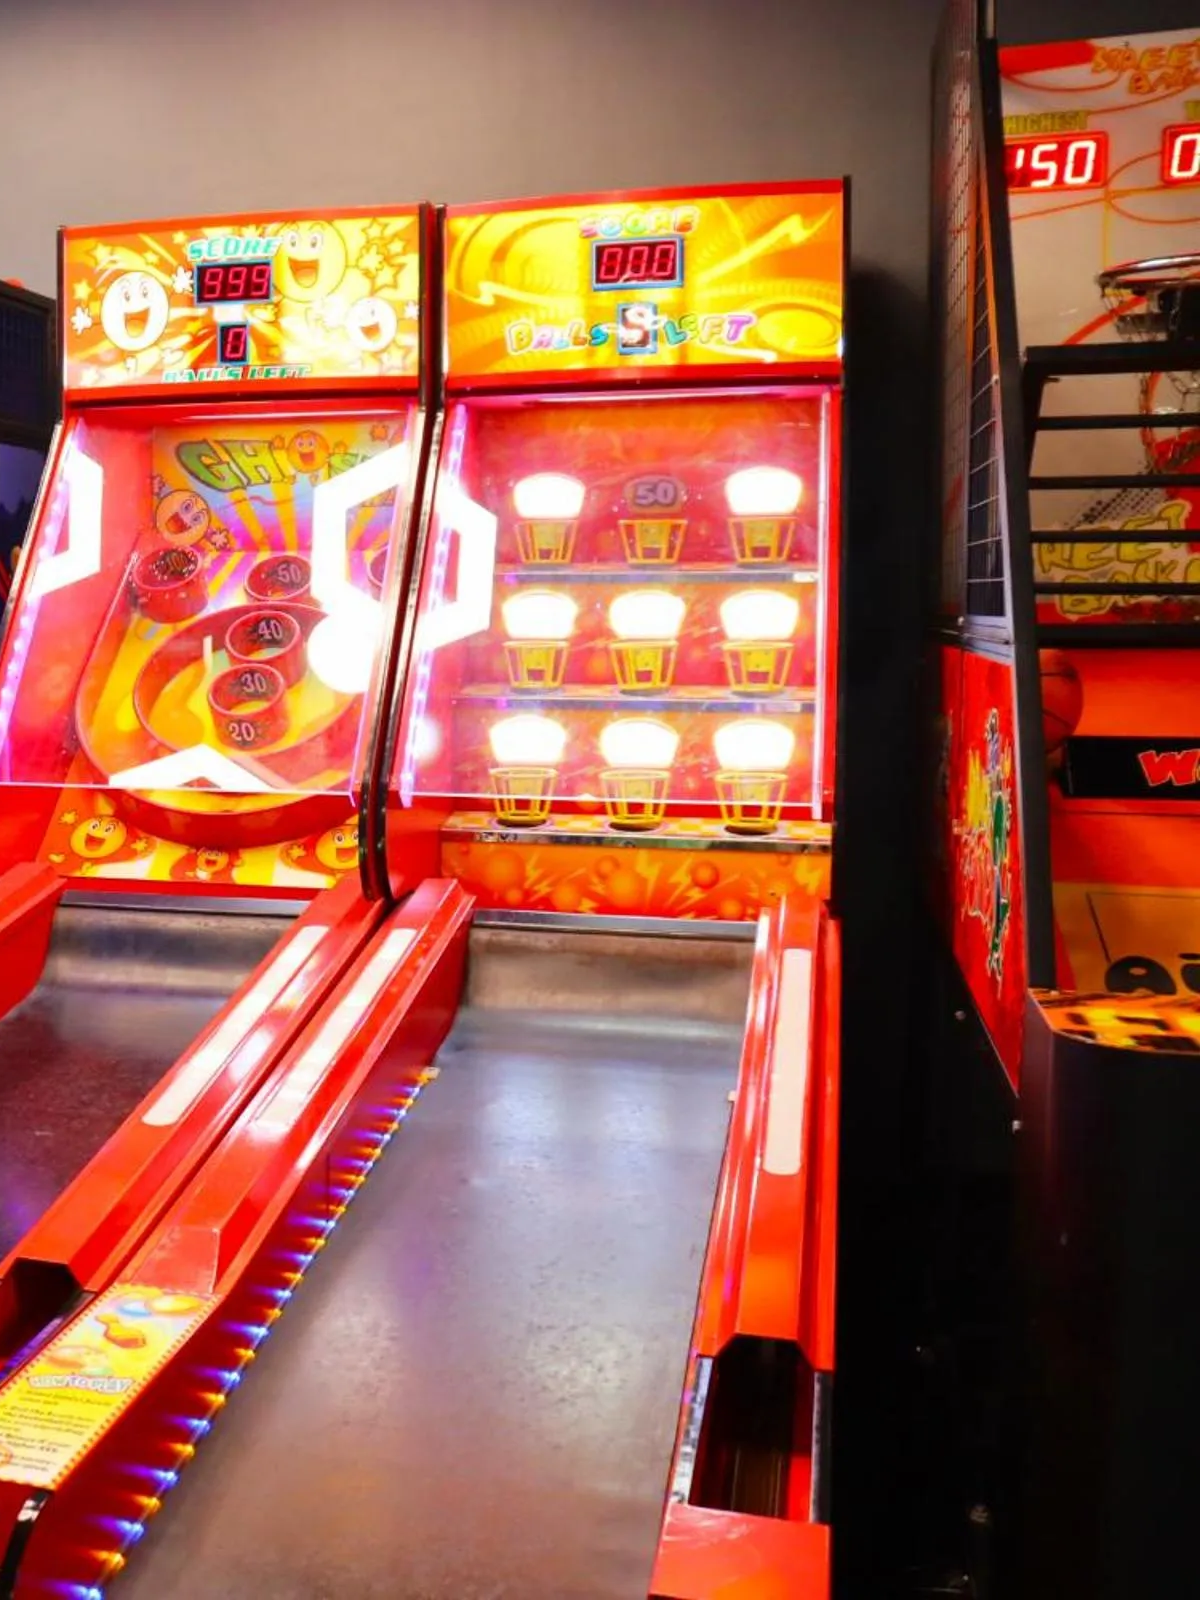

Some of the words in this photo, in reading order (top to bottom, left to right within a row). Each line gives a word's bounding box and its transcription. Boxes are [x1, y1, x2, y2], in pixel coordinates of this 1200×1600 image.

[599, 244, 675, 279] 000
[203, 265, 271, 299] 999
[226, 327, 248, 358] 0
[663, 314, 753, 346] LEFT
[634, 481, 675, 507] 50
[277, 562, 302, 584] 50
[257, 620, 283, 640] 40
[241, 672, 267, 693] 30
[228, 722, 256, 741] 20
[1138, 749, 1200, 786] W
